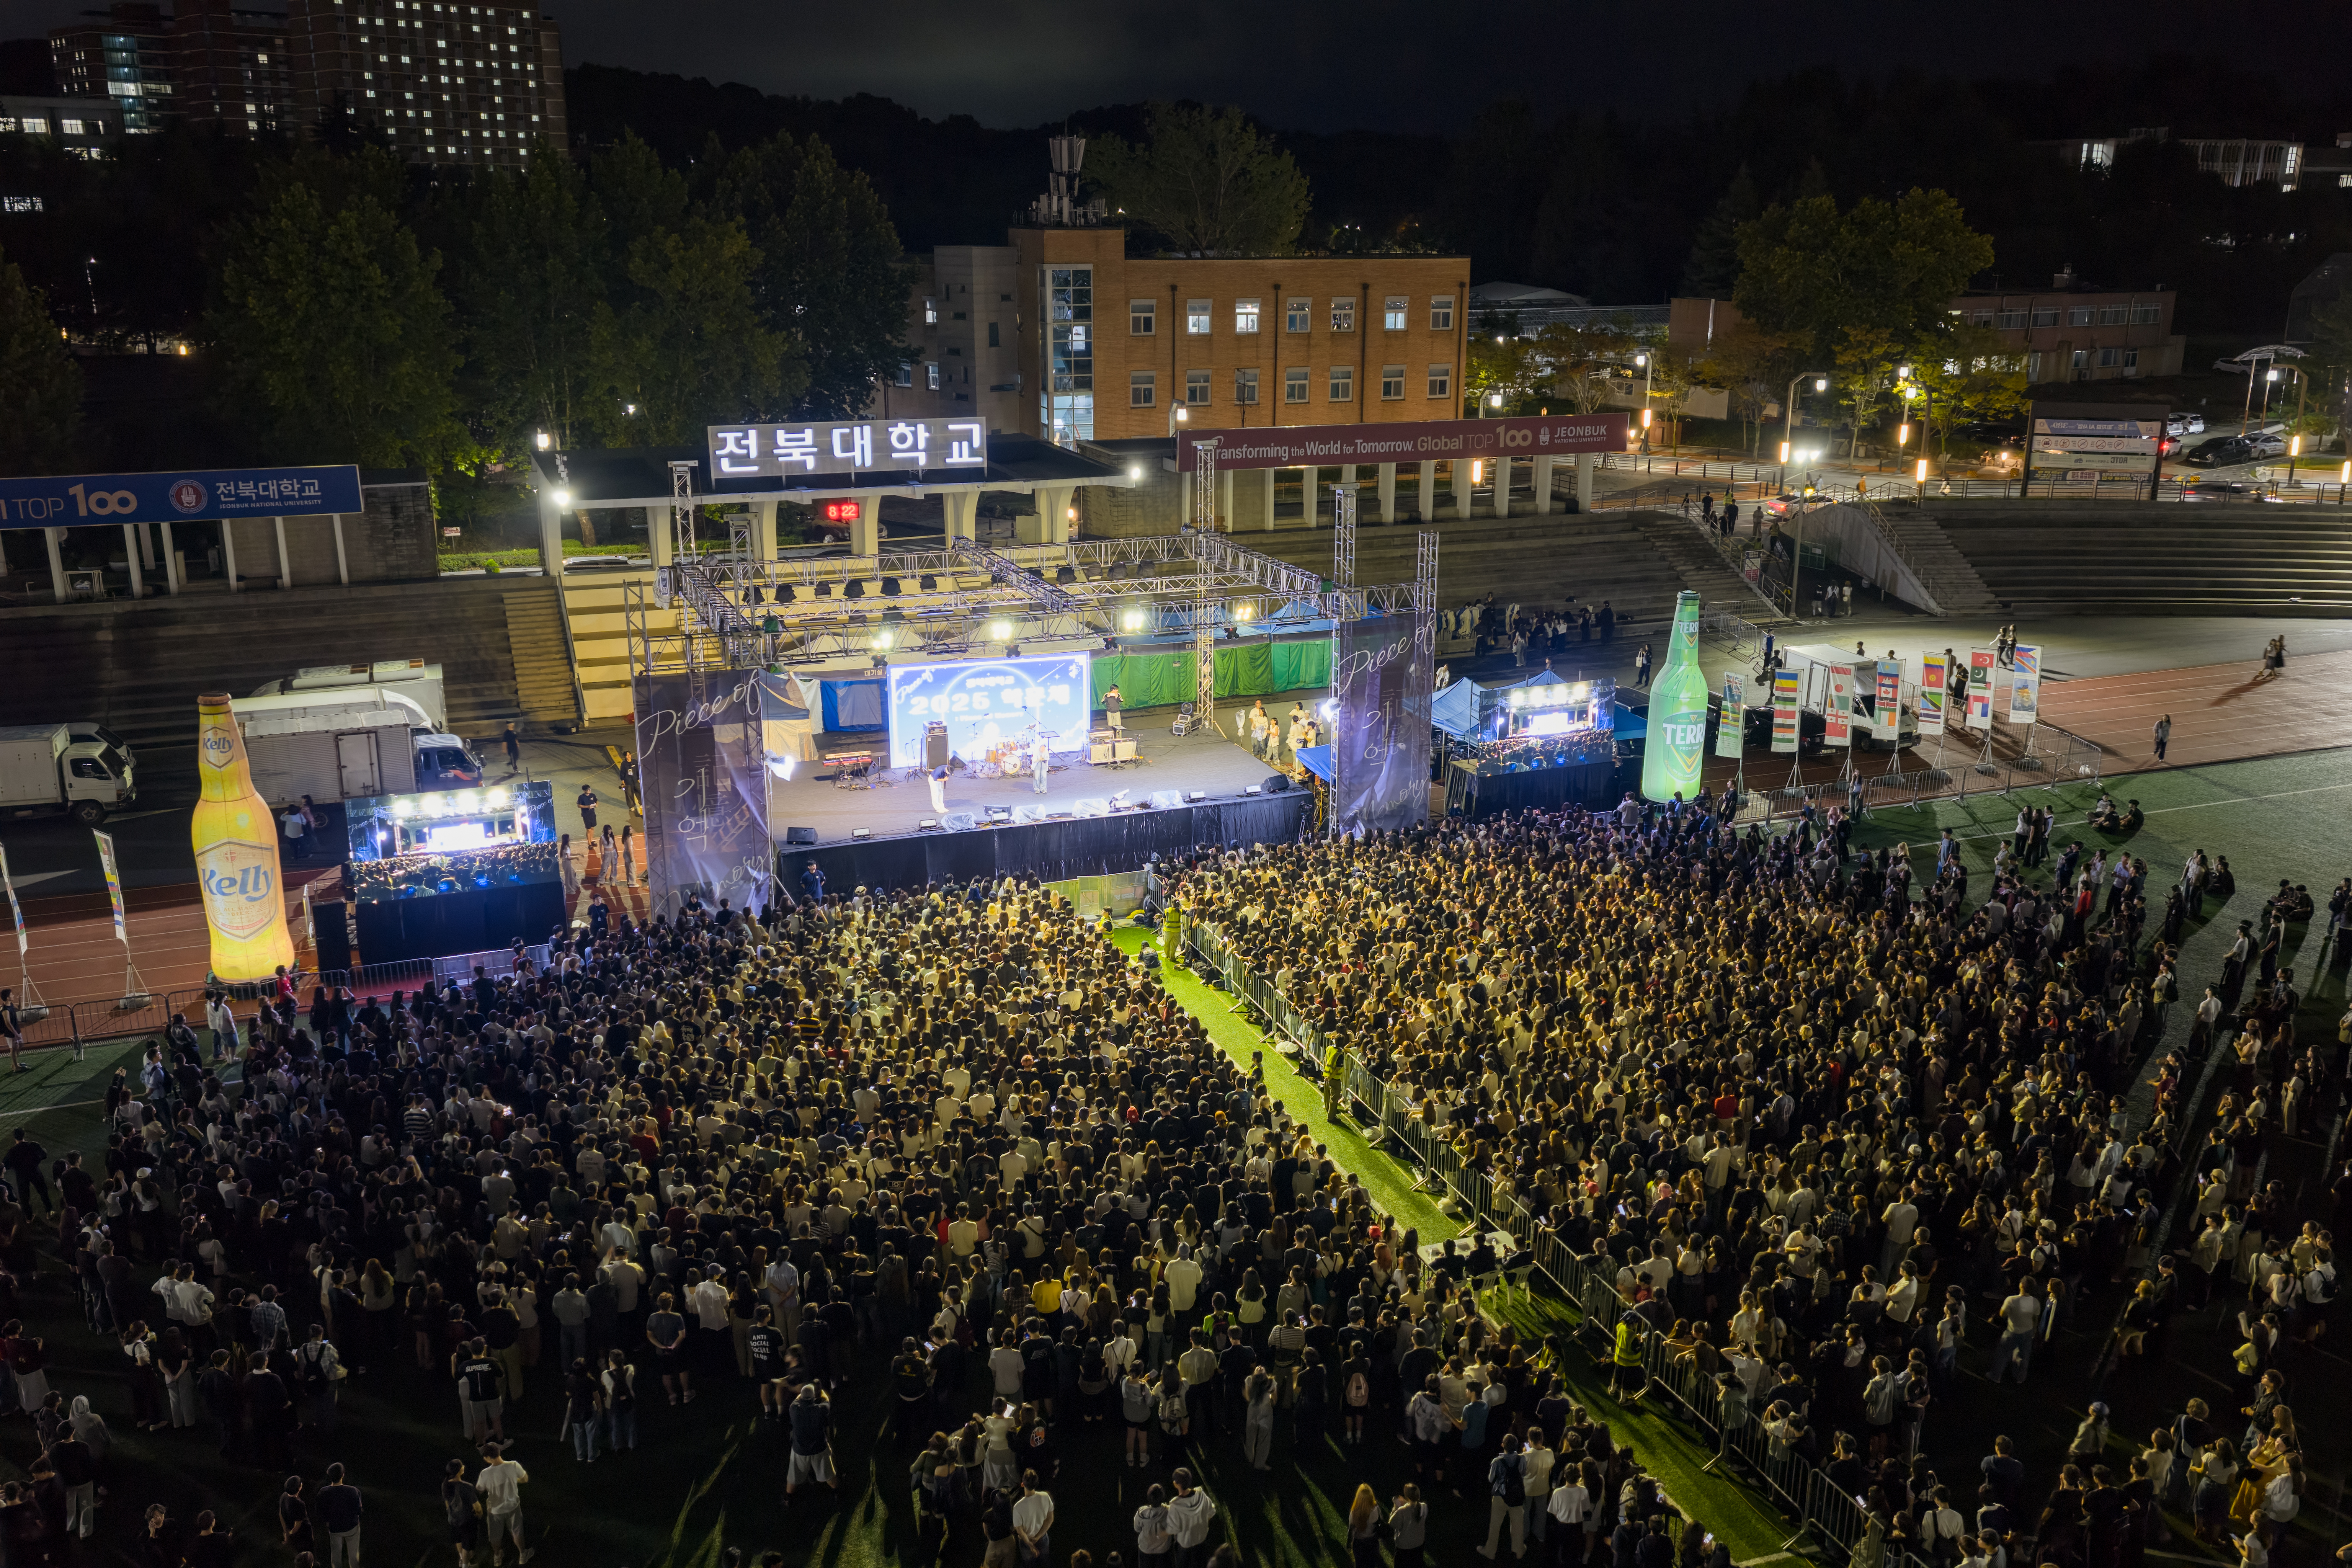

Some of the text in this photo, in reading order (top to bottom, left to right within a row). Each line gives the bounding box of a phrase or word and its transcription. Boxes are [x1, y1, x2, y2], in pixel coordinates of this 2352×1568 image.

[1212, 424, 1532, 461] ransforming the World for Tomorrow. Global TOP 100
[1554, 425, 1607, 437] JEONBUK
[715, 423, 983, 472] 전북대학교
[11, 498, 64, 519] TOP
[68, 483, 137, 516] 100
[216, 479, 321, 501] 전북대학교
[1415, 613, 1435, 654] of
[1679, 621, 1699, 633] TERR
[733, 669, 760, 715] of
[908, 691, 991, 715] 2025
[203, 737, 234, 754] Kelly
[201, 864, 273, 902] Kelly
[466, 1363, 490, 1372] SUPREME
